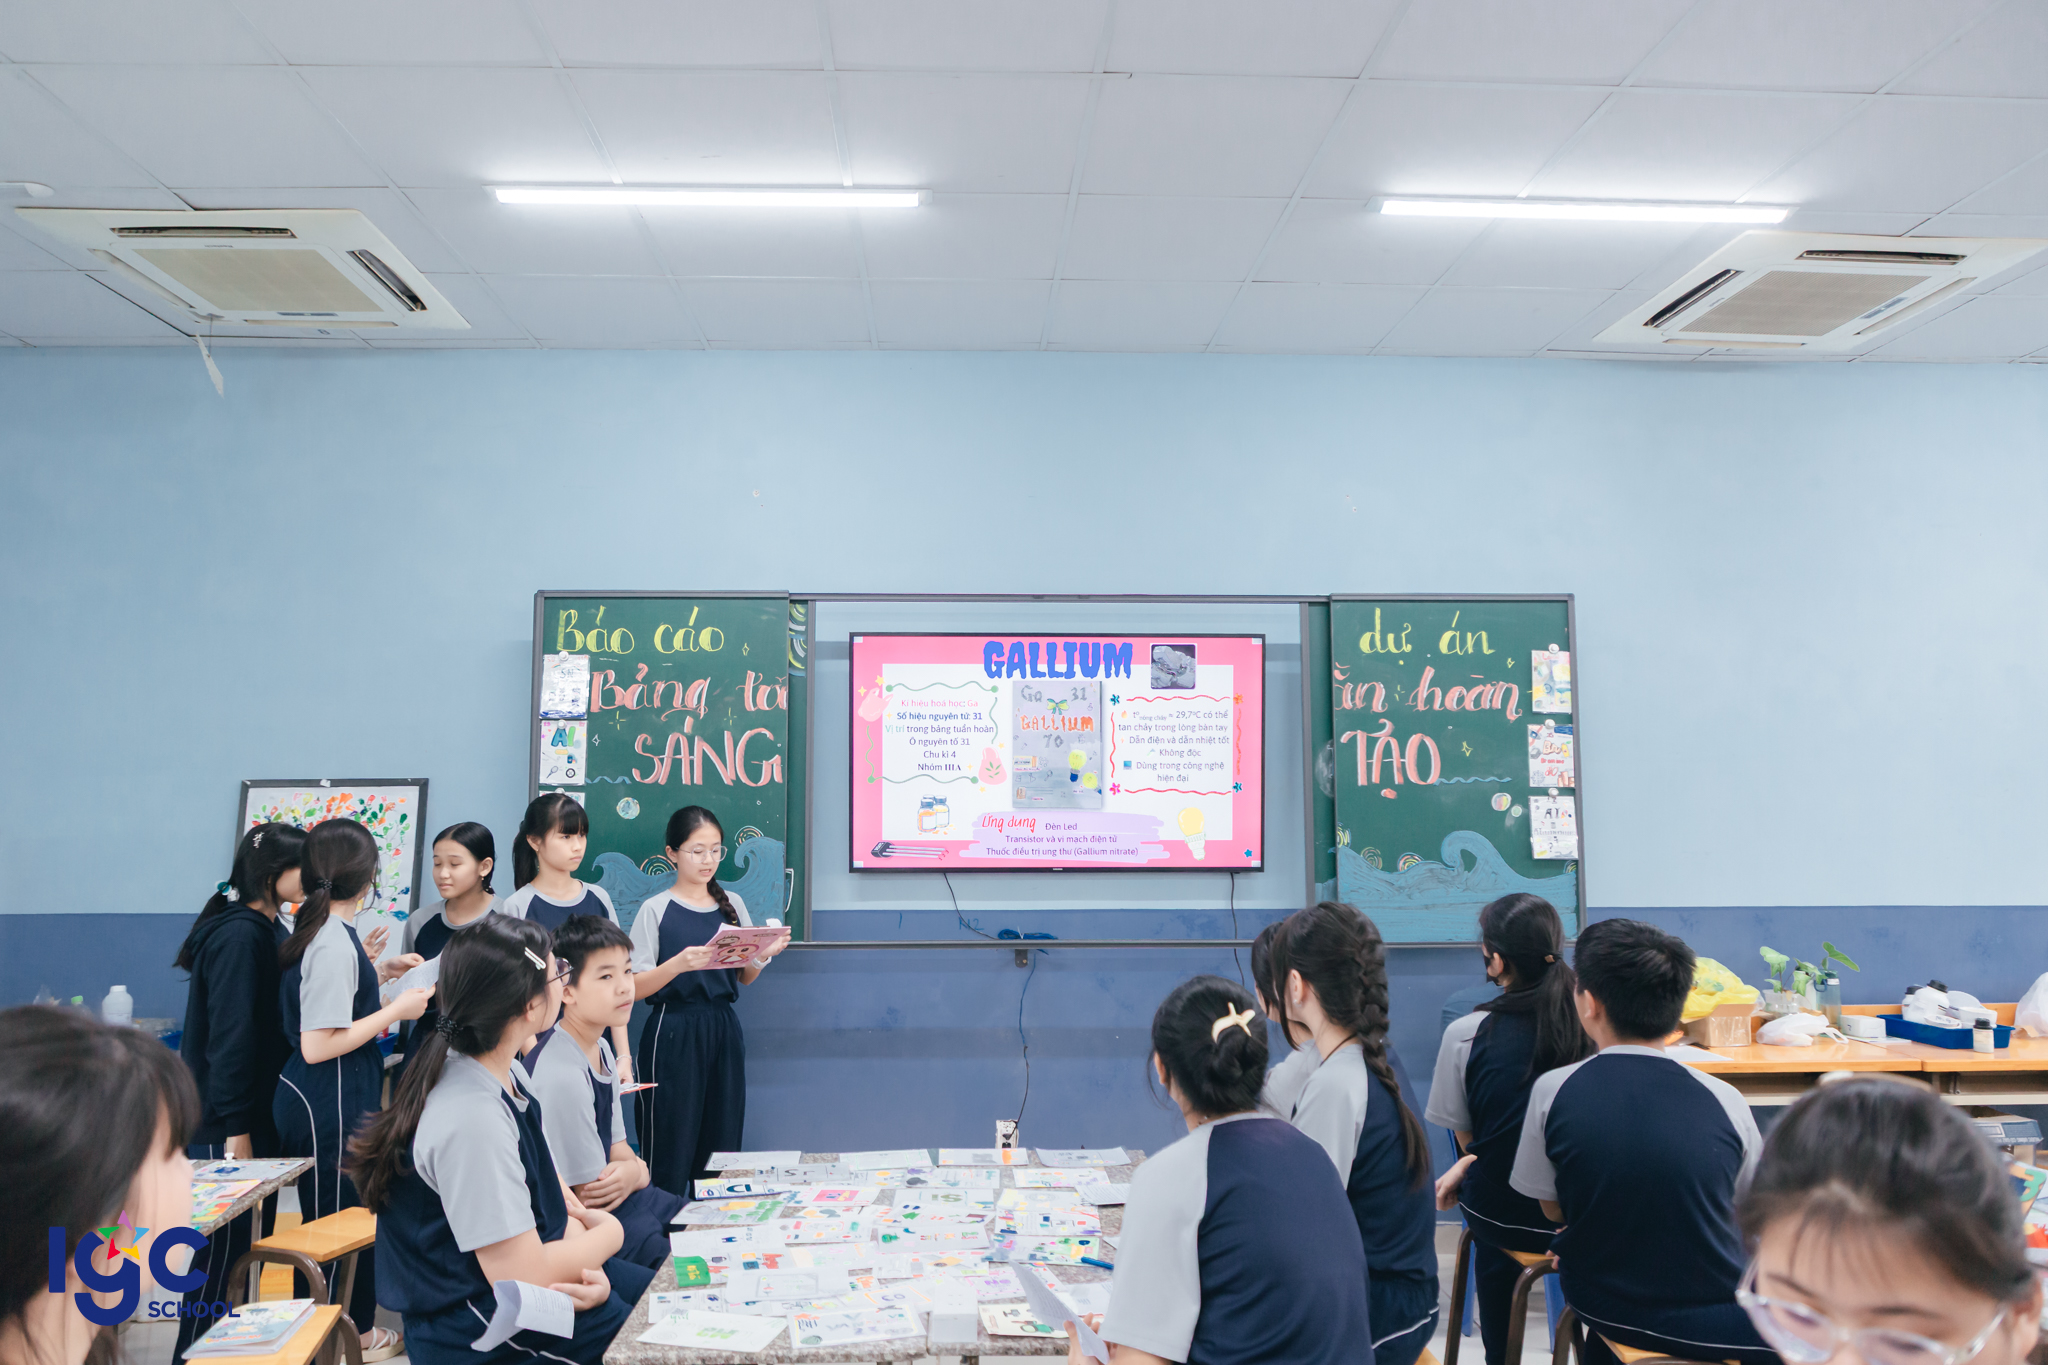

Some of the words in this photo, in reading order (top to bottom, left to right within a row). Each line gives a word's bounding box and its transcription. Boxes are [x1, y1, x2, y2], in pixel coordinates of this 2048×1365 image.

[556, 605, 635, 654] Báo
[654, 605, 725, 654] cáo
[1439, 610, 1496, 656] án
[983, 641, 1133, 679] GALLIUM
[590, 663, 711, 721] Bảng
[1071, 686, 1087, 702] 31
[967, 699, 978, 707] Ga
[897, 711, 907, 720] Số
[909, 712, 927, 721] hiệu
[929, 712, 958, 722] nguyên
[972, 712, 982, 720] 31
[1203, 711, 1213, 719] có
[1020, 714, 1094, 732] GALLIUM
[906, 726, 929, 735] trong
[1155, 724, 1176, 733] trong
[1215, 724, 1228, 733] tay
[918, 738, 948, 747] nguyên
[960, 738, 970, 746] 31
[632, 716, 783, 787] SÁNG
[923, 750, 940, 758] Chu
[1159, 748, 1185, 758] Không
[1340, 718, 1442, 799] TẠO
[917, 763, 943, 771] Nhóm
[944, 763, 962, 771] IIIA
[1159, 762, 1181, 771] trong
[982, 813, 1005, 833] Ứng
[1007, 815, 1036, 833] dụng
[1045, 823, 1061, 831] Đèn
[1063, 823, 1078, 831] Led
[1005, 835, 1044, 843] Transistor
[1066, 835, 1088, 844] mạch
[1089, 835, 1107, 844] điện
[986, 846, 1011, 856] Thuốc
[1042, 849, 1057, 857] ung
[1074, 847, 1107, 857] (Gallium
[1109, 847, 1139, 857] nitrate)
